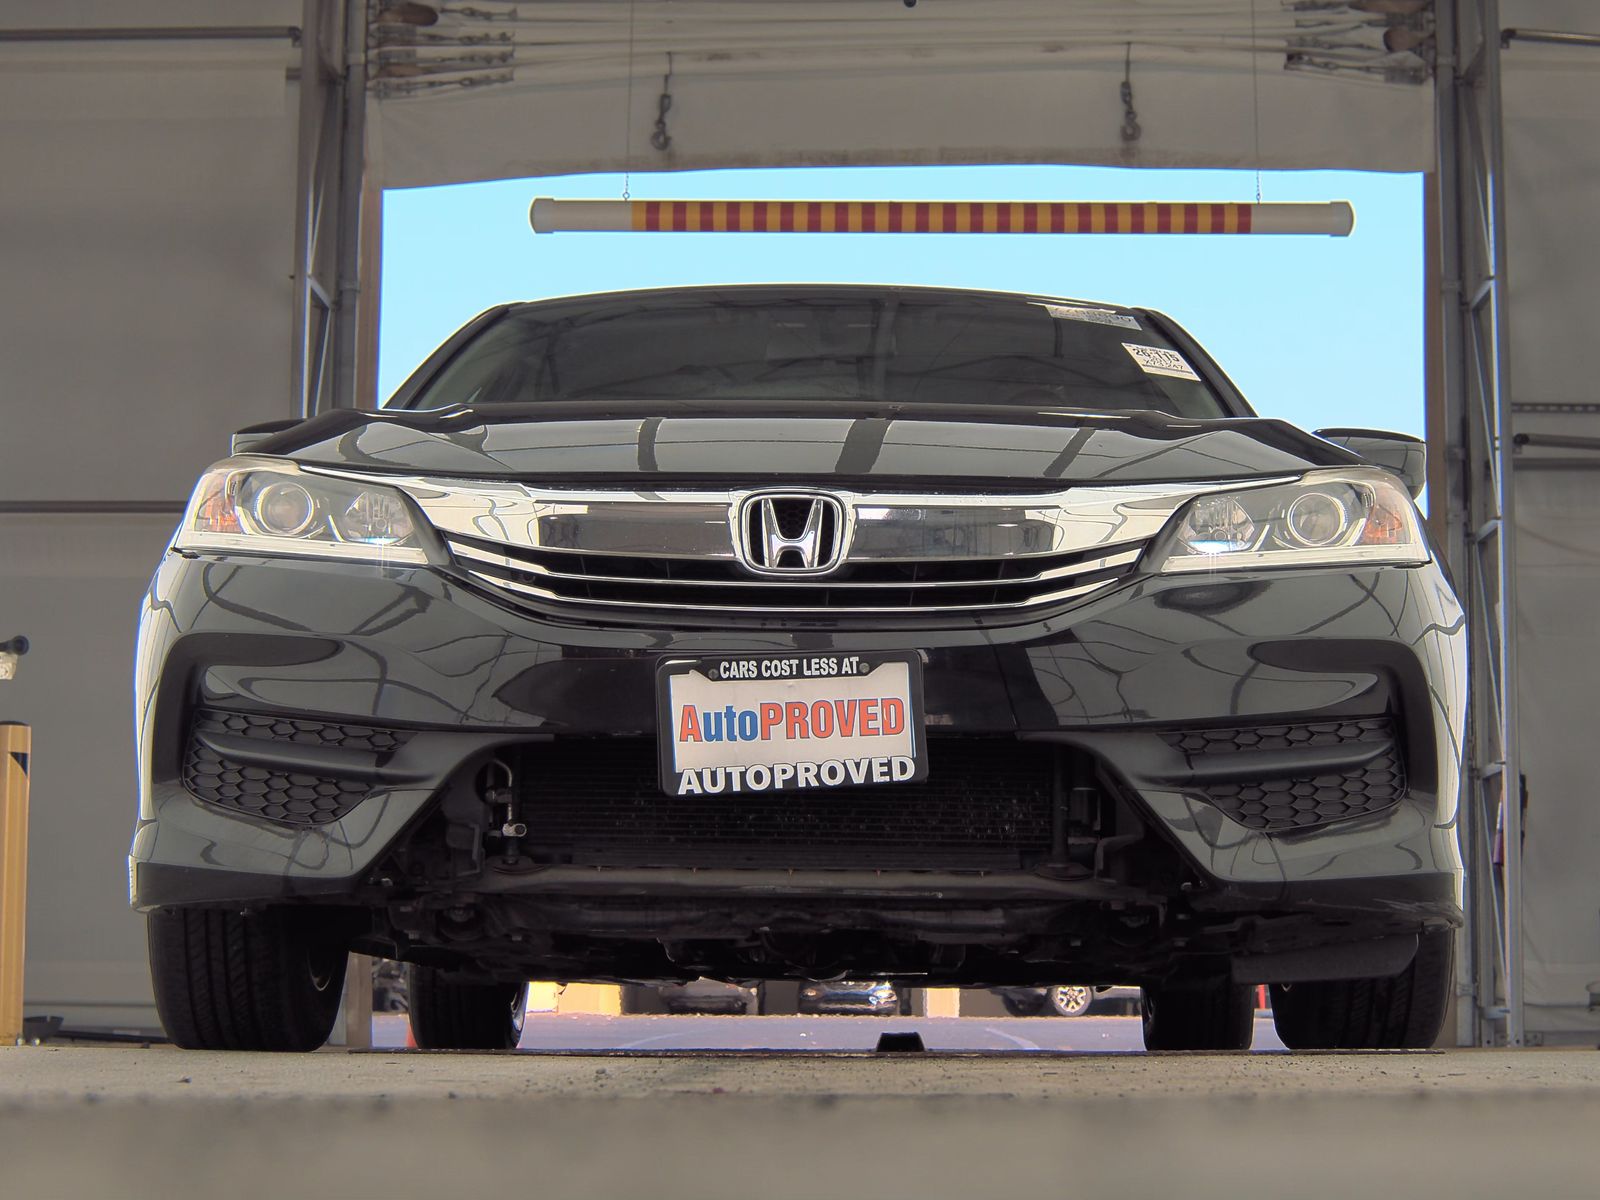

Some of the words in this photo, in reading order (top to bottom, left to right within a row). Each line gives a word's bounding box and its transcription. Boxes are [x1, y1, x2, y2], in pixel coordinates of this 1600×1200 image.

[719, 660, 758, 679] CARS
[761, 659, 799, 677] COST
[803, 658, 838, 676] LESS
[841, 656, 860, 674] AT
[679, 697, 905, 742] AutoPROVED
[677, 755, 916, 795] AUTOPROVED
